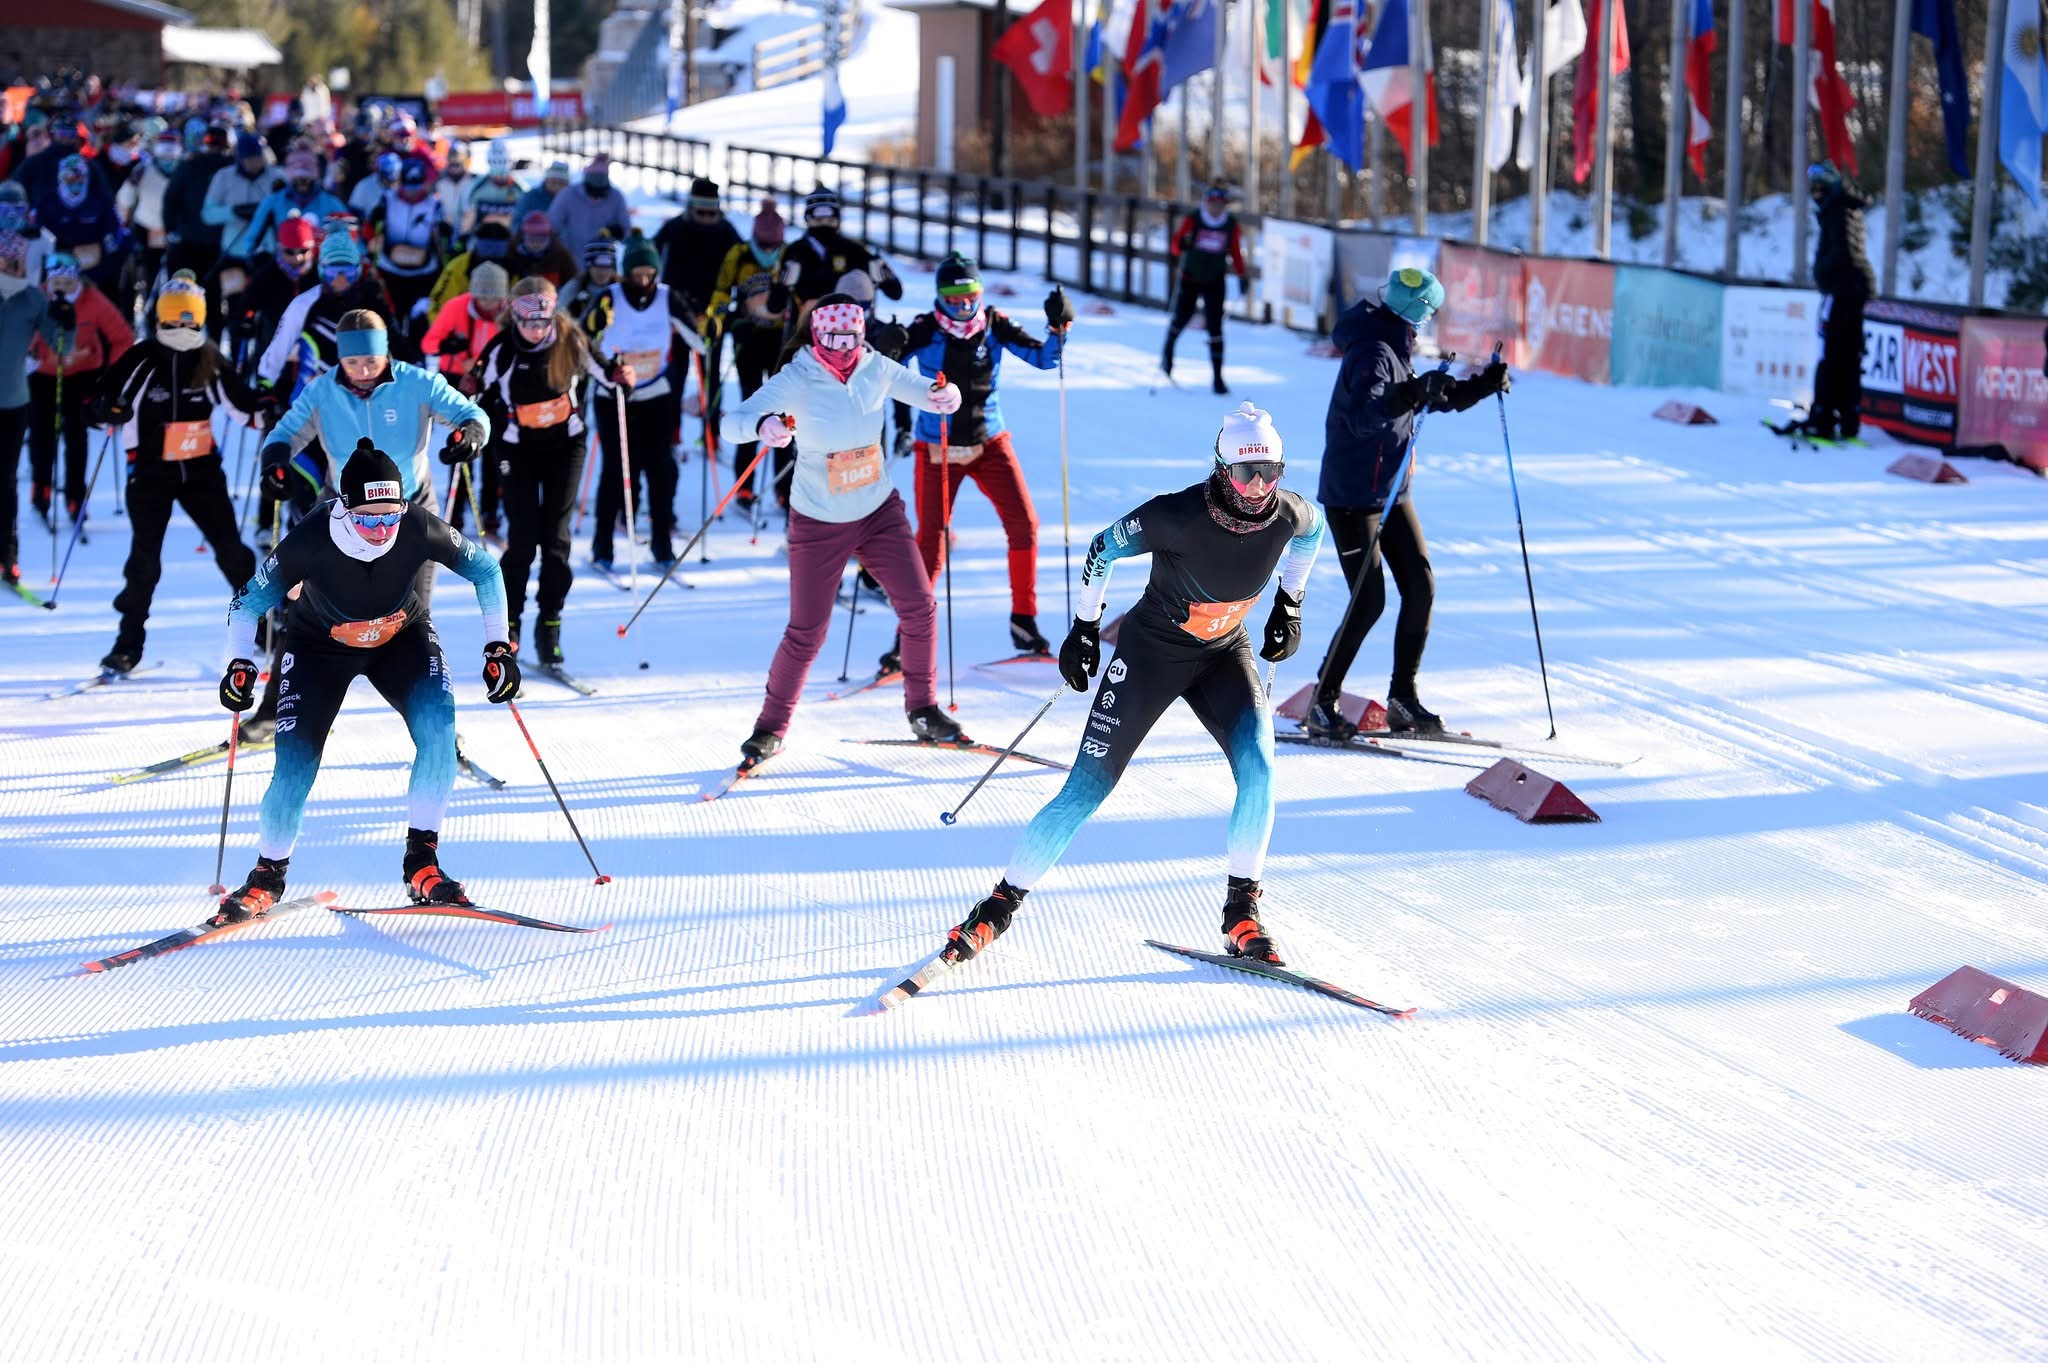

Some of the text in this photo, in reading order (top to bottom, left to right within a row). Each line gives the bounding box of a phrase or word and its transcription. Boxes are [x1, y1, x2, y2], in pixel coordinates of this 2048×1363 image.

[1859, 331, 1958, 396] EAR WEST
[1975, 364, 2022, 402] KARI
[1238, 446, 1270, 456] BIRKIE
[841, 464, 873, 485] 1043
[367, 487, 398, 499] BIRKIE
[1227, 604, 1241, 615] DE
[368, 617, 384, 627] DE
[1207, 614, 1231, 633] 37
[429, 656, 439, 677] TEAM
[1109, 665, 1124, 677] GU
[1090, 709, 1121, 727] Tamarack
[1090, 719, 1112, 734] Health
